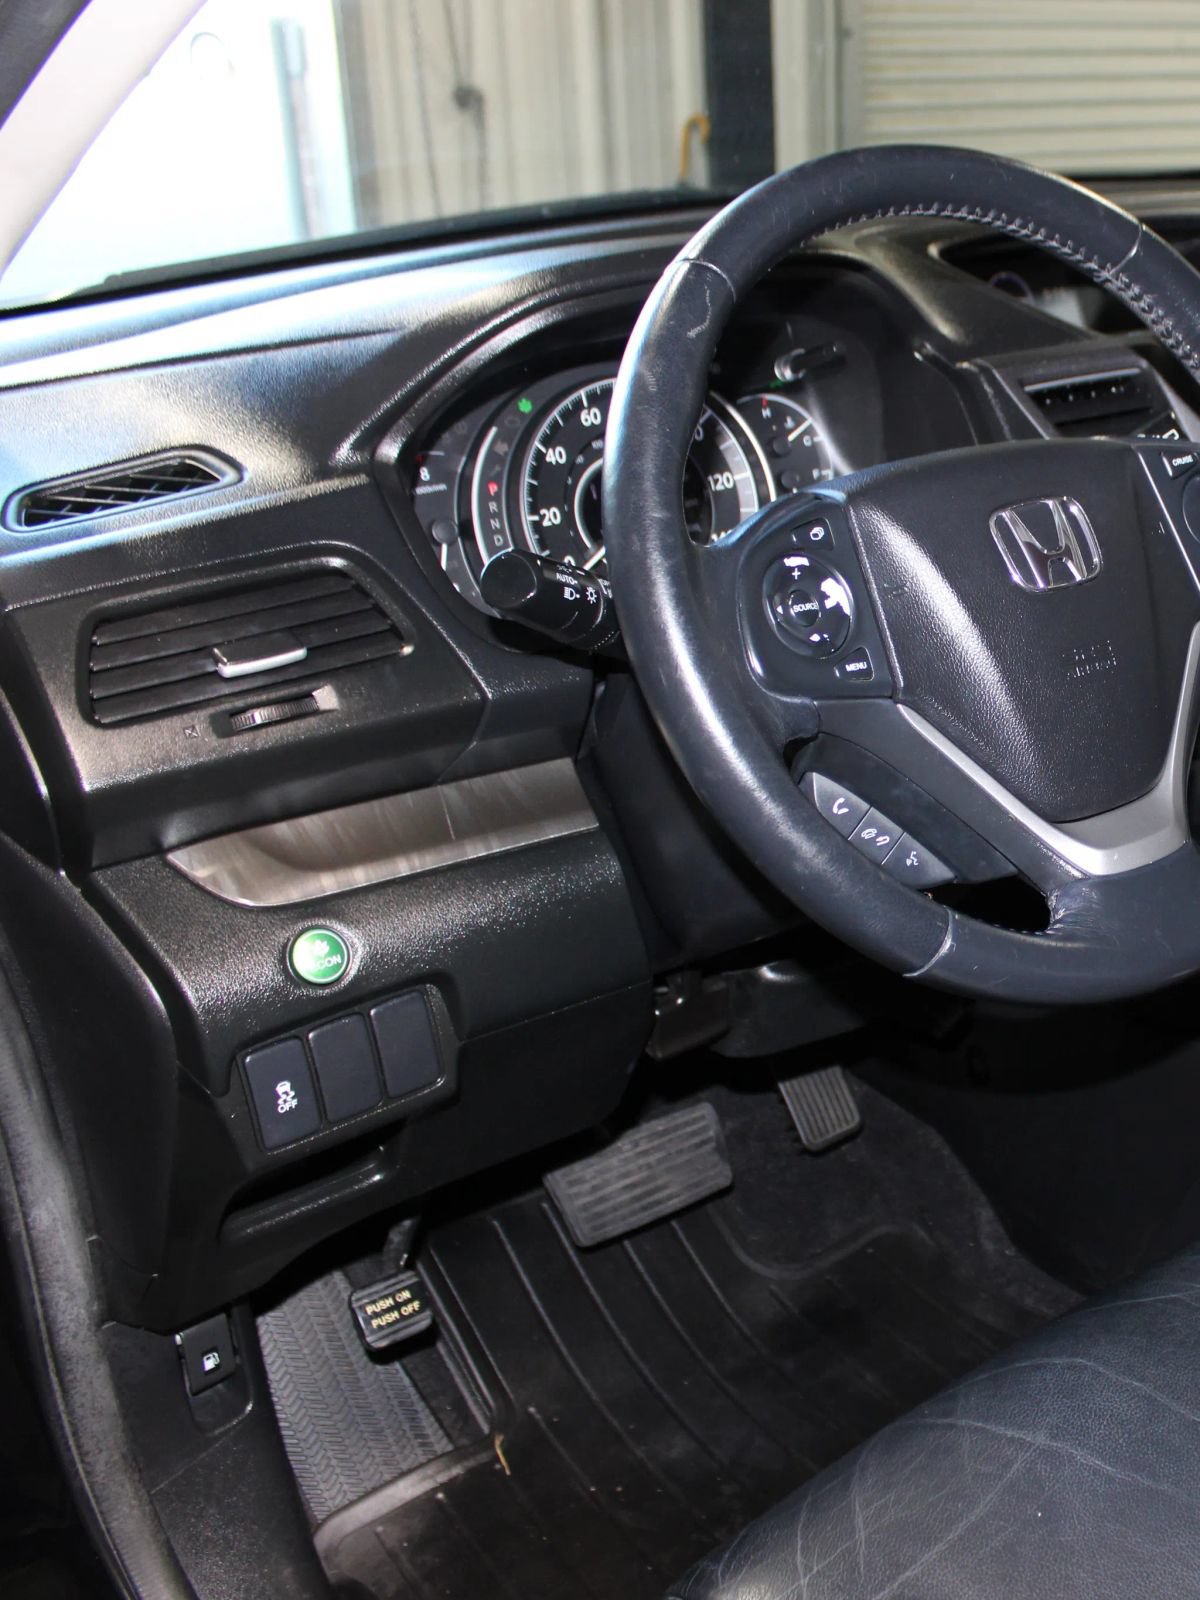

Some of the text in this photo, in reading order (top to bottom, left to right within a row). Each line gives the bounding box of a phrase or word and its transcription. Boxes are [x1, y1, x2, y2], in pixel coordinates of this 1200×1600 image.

[581, 407, 601, 427] 60
[545, 446, 567, 466] 40
[1172, 454, 1194, 467] CRUISE
[419, 466, 430, 482] 8
[708, 471, 734, 491] 120
[488, 482, 498, 496] P
[488, 501, 498, 513] R
[490, 518, 501, 530] N
[540, 507, 561, 527] 20
[494, 535, 504, 547] D
[556, 572, 575, 585] AUTO
[792, 601, 819, 614] SOURCE
[845, 660, 867, 672] MENU
[277, 1098, 298, 1114] OFF
[365, 1289, 412, 1316] PUSH ON
[371, 1300, 421, 1329] PUSH OFF
